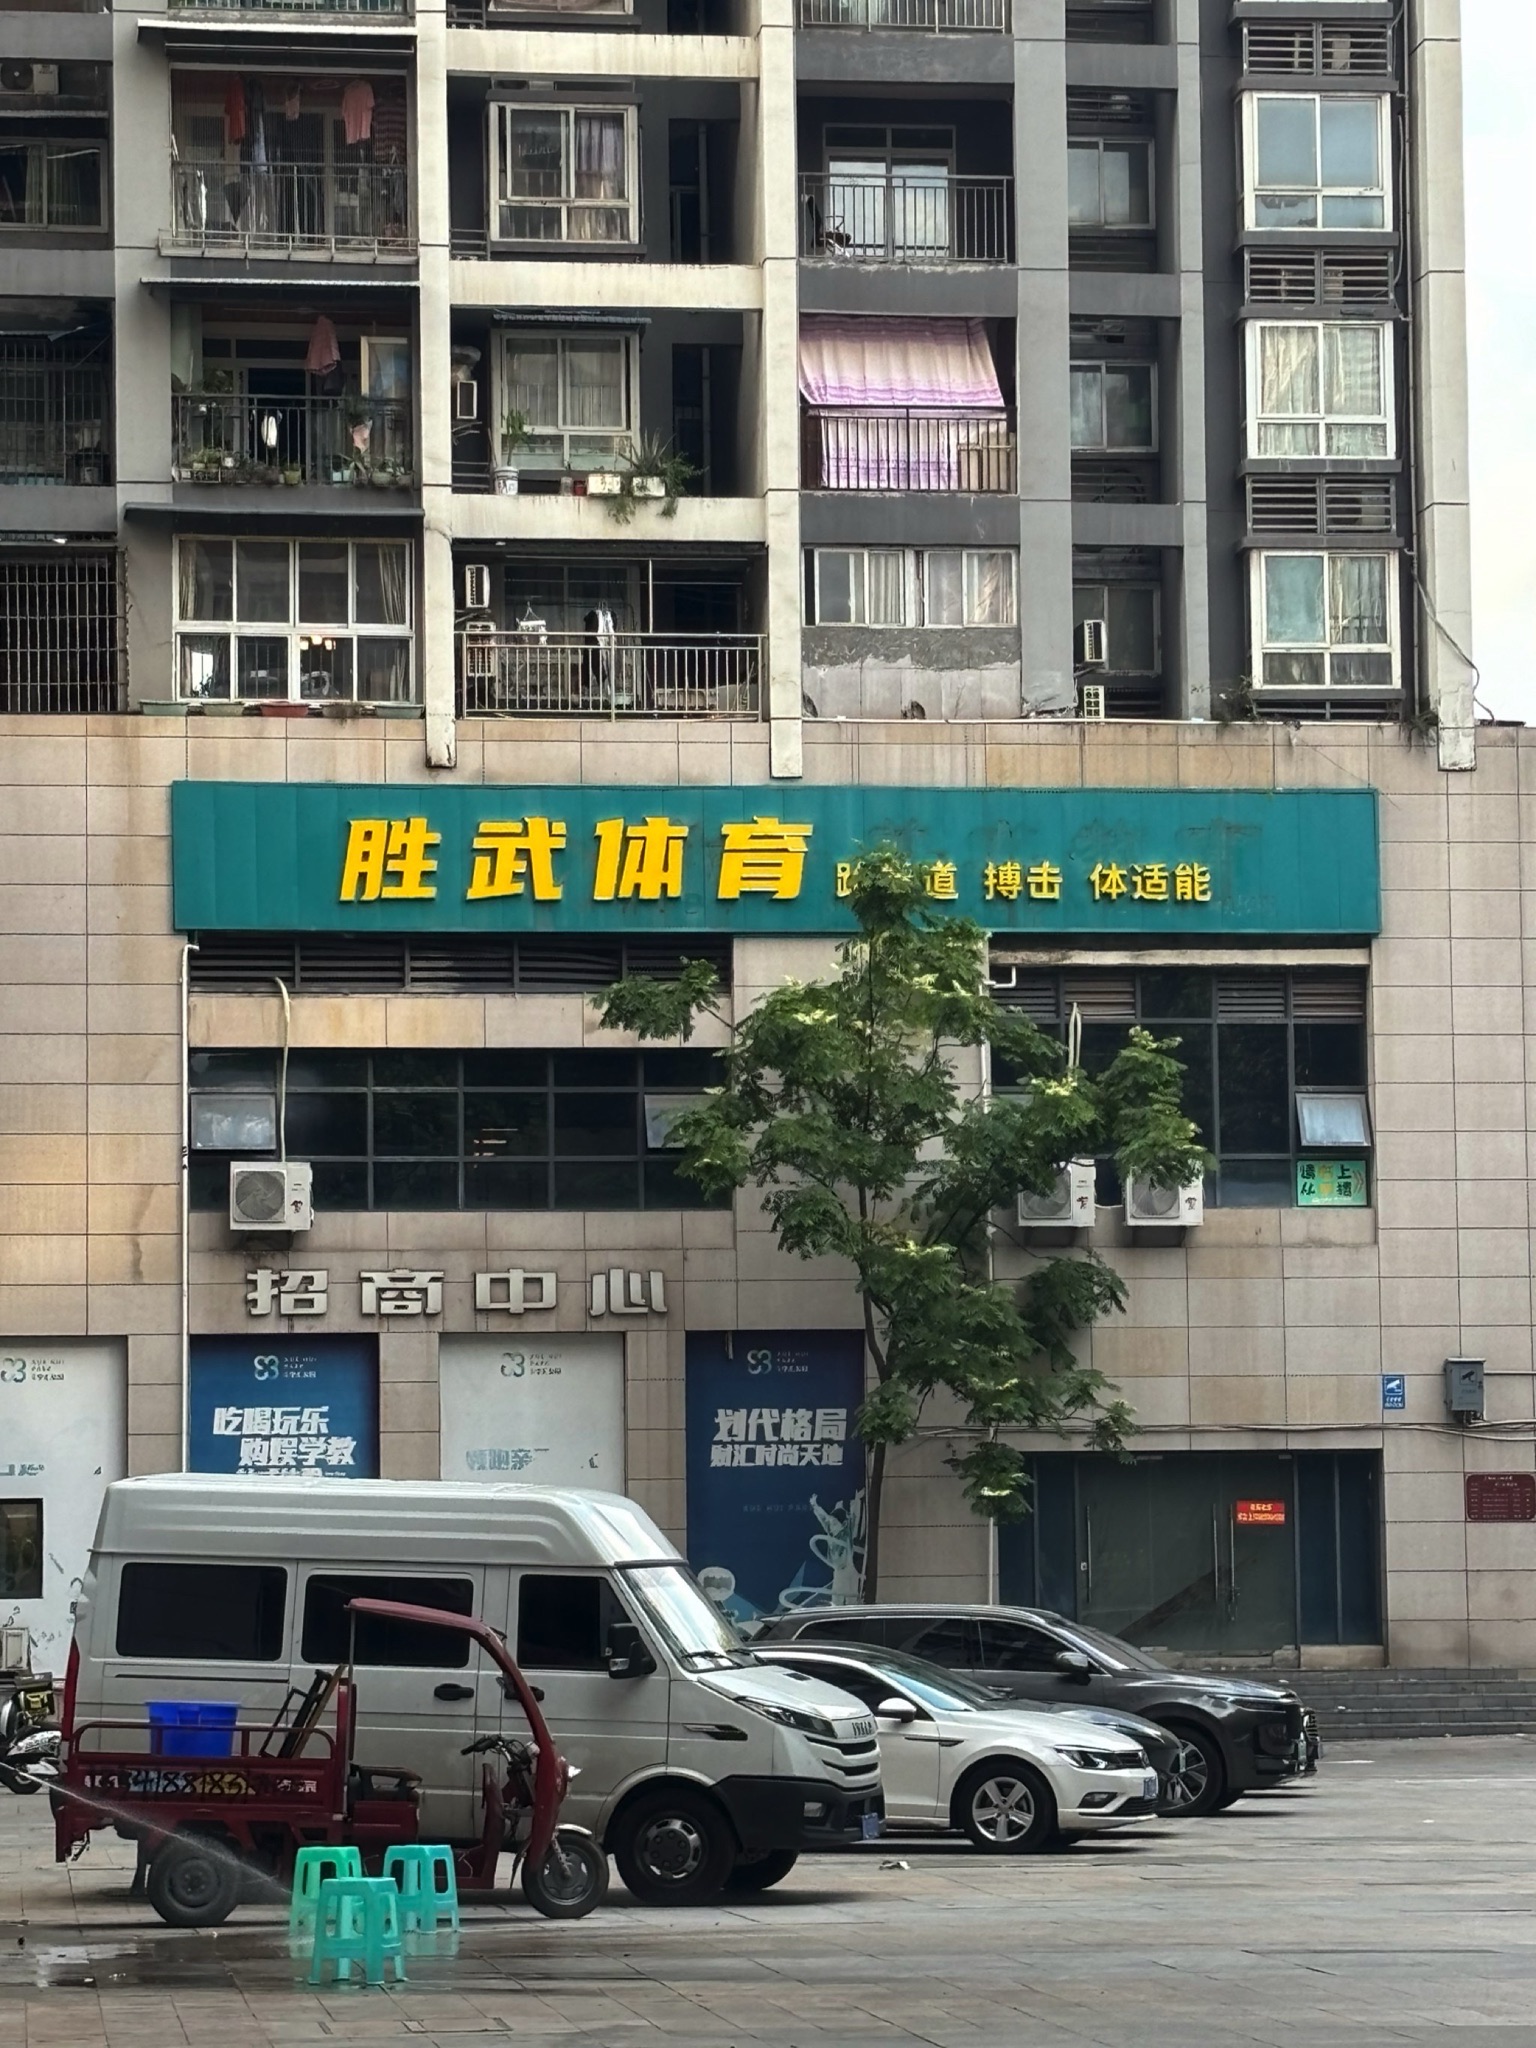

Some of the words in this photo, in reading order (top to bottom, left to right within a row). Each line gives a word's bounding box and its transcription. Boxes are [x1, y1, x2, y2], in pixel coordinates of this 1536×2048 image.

[339, 815, 815, 901] 胜武体育
[984, 860, 1063, 900] 搏击
[1089, 861, 1212, 901] 体适能
[247, 1268, 668, 1317] 招商中心
[213, 1406, 330, 1435] 吃喝玩乐
[713, 1407, 847, 1442] 划代格局
